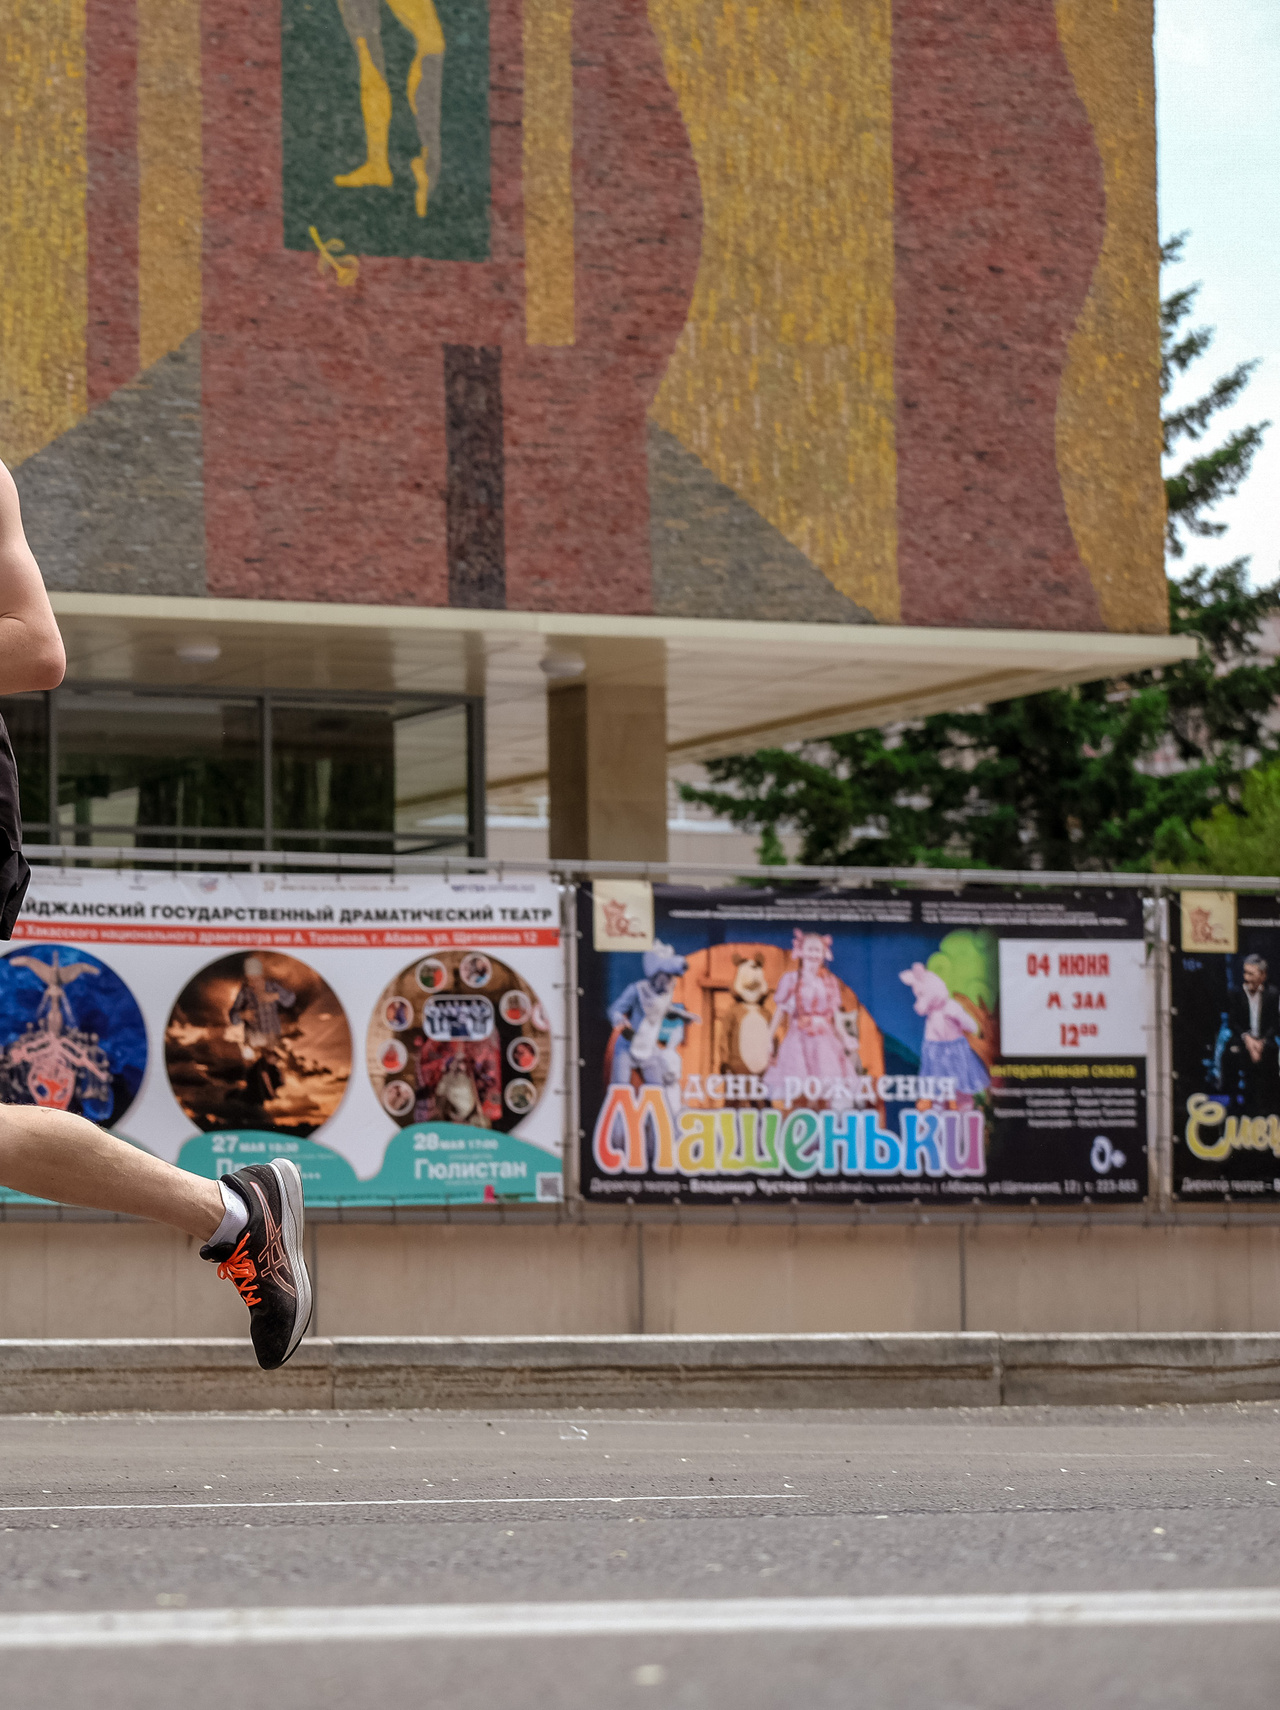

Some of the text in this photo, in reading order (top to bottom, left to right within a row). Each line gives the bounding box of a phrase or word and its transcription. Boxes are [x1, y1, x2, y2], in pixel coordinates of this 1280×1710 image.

[19, 898, 553, 925] ЙДЖАНСКИЙ ГОСУДАРСТВЕННЫЙ ДРАМАТИЧЕСКИЙ ТЕАТР
[523, 932, 537, 944] 12
[1027, 953, 1109, 977] 04 ИЮНЯ
[1072, 991, 1107, 1009] ЗАЛ
[989, 1064, 1137, 1079] интерактивная сказка
[683, 1074, 958, 1107] день рождения
[593, 1083, 987, 1177] Машеньки
[212, 1134, 239, 1153] 27
[413, 1132, 439, 1151] 28
[1090, 1135, 1127, 1174] 0+
[414, 1158, 527, 1180] Гюлистан
